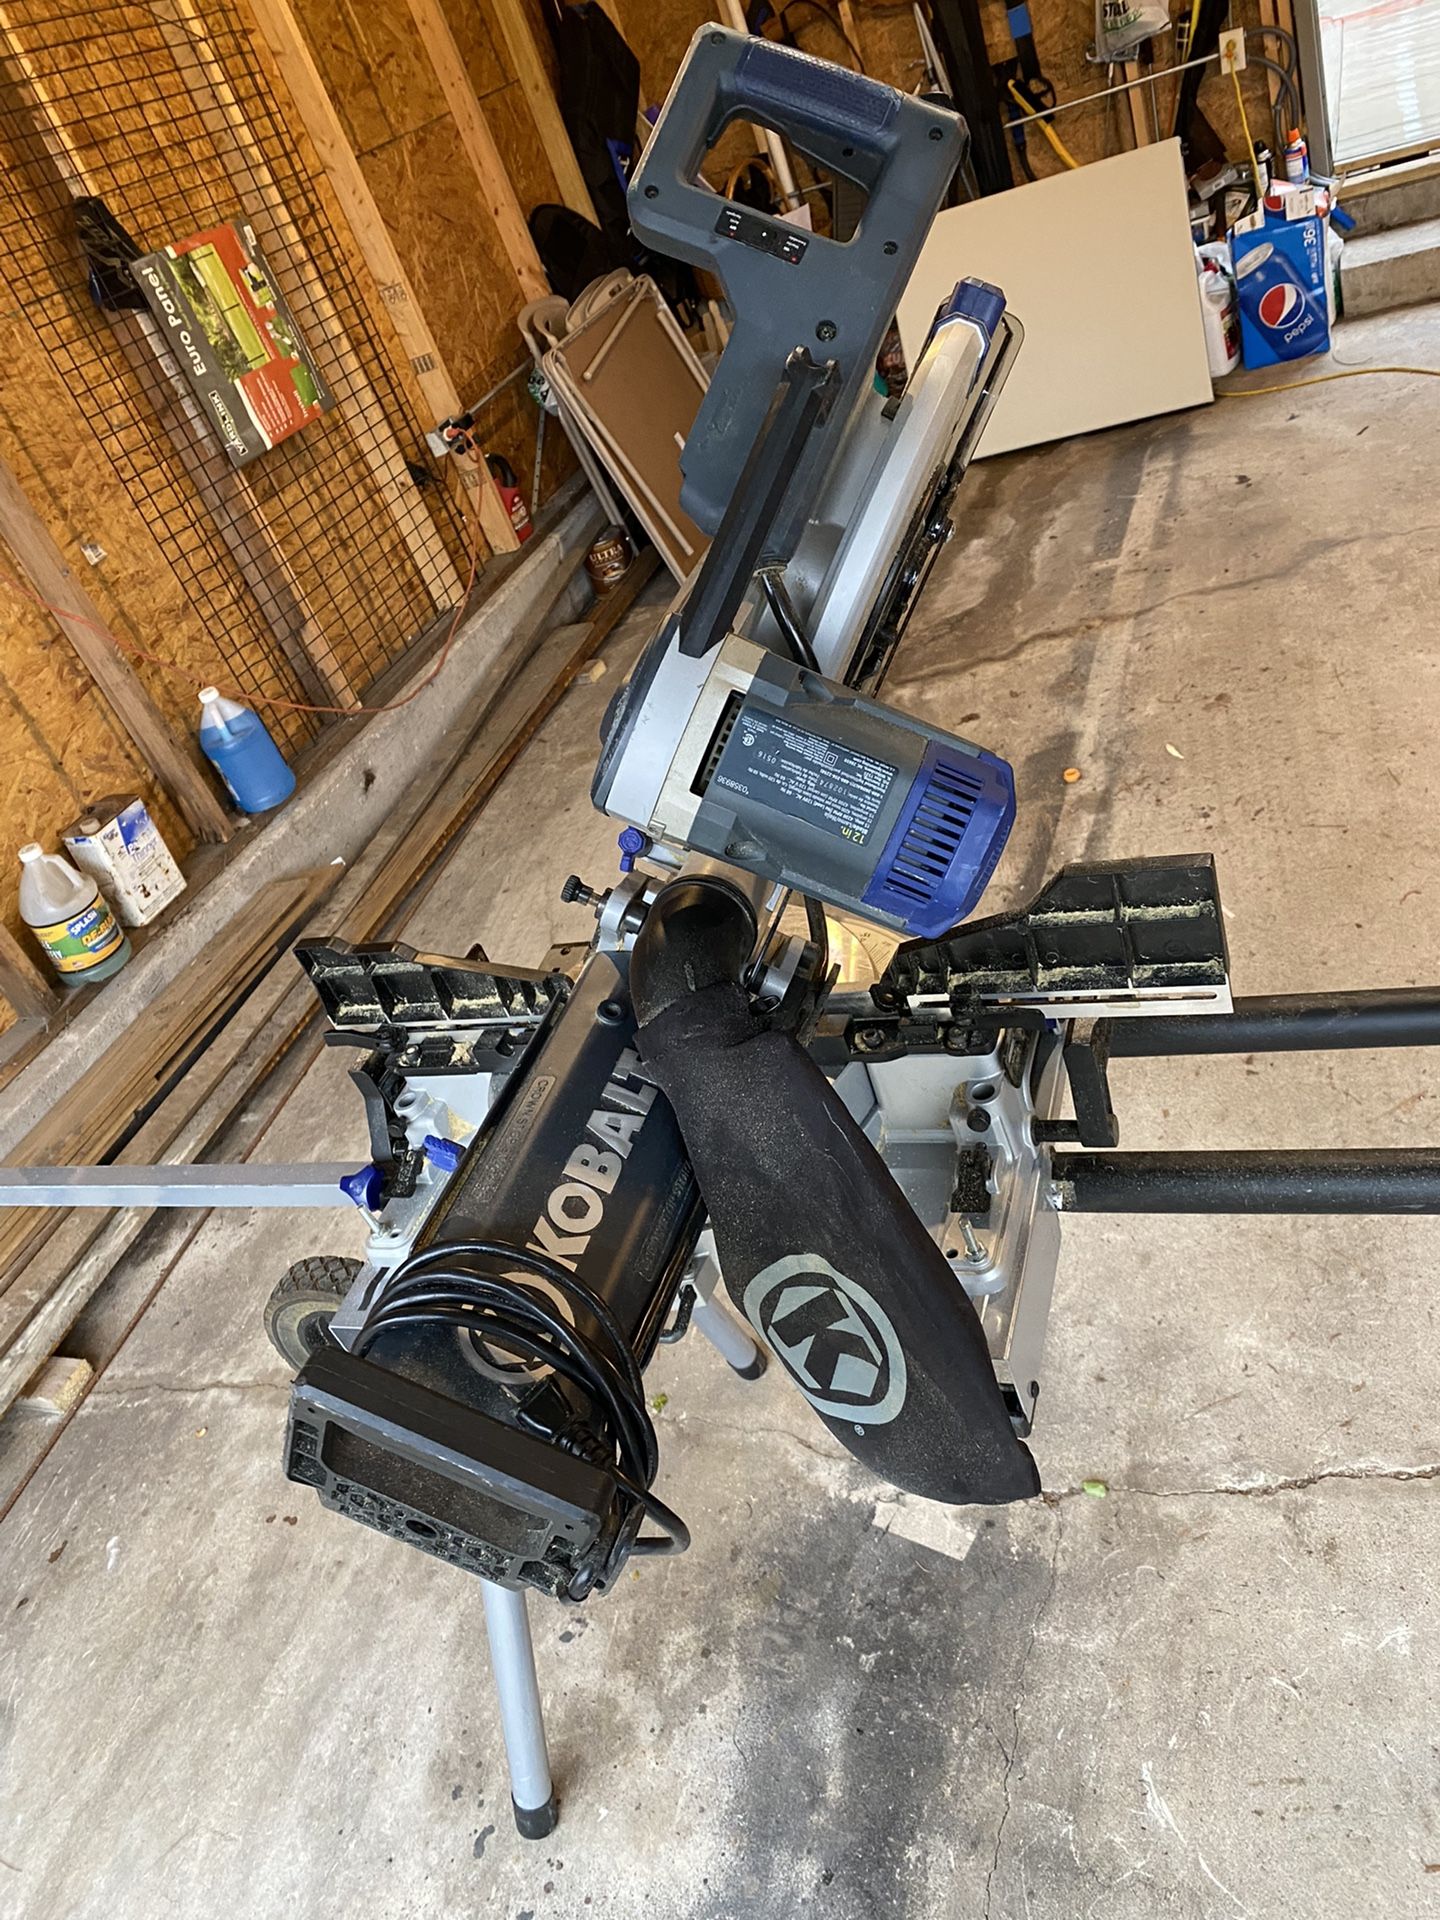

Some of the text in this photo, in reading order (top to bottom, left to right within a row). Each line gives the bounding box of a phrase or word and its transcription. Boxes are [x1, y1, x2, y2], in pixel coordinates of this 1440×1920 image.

[1303, 228, 1317, 247] 36
[141, 265, 208, 377] Euro Panel
[1283, 313, 1315, 344] pepsi
[210, 392, 246, 453] YARDLINK
[589, 544, 623, 561] ULTRA
[756, 750, 777, 764] 0516
[839, 825, 865, 844] 12 in.
[70, 909, 98, 935] SPLASH
[525, 1048, 658, 1272] KOBALT
